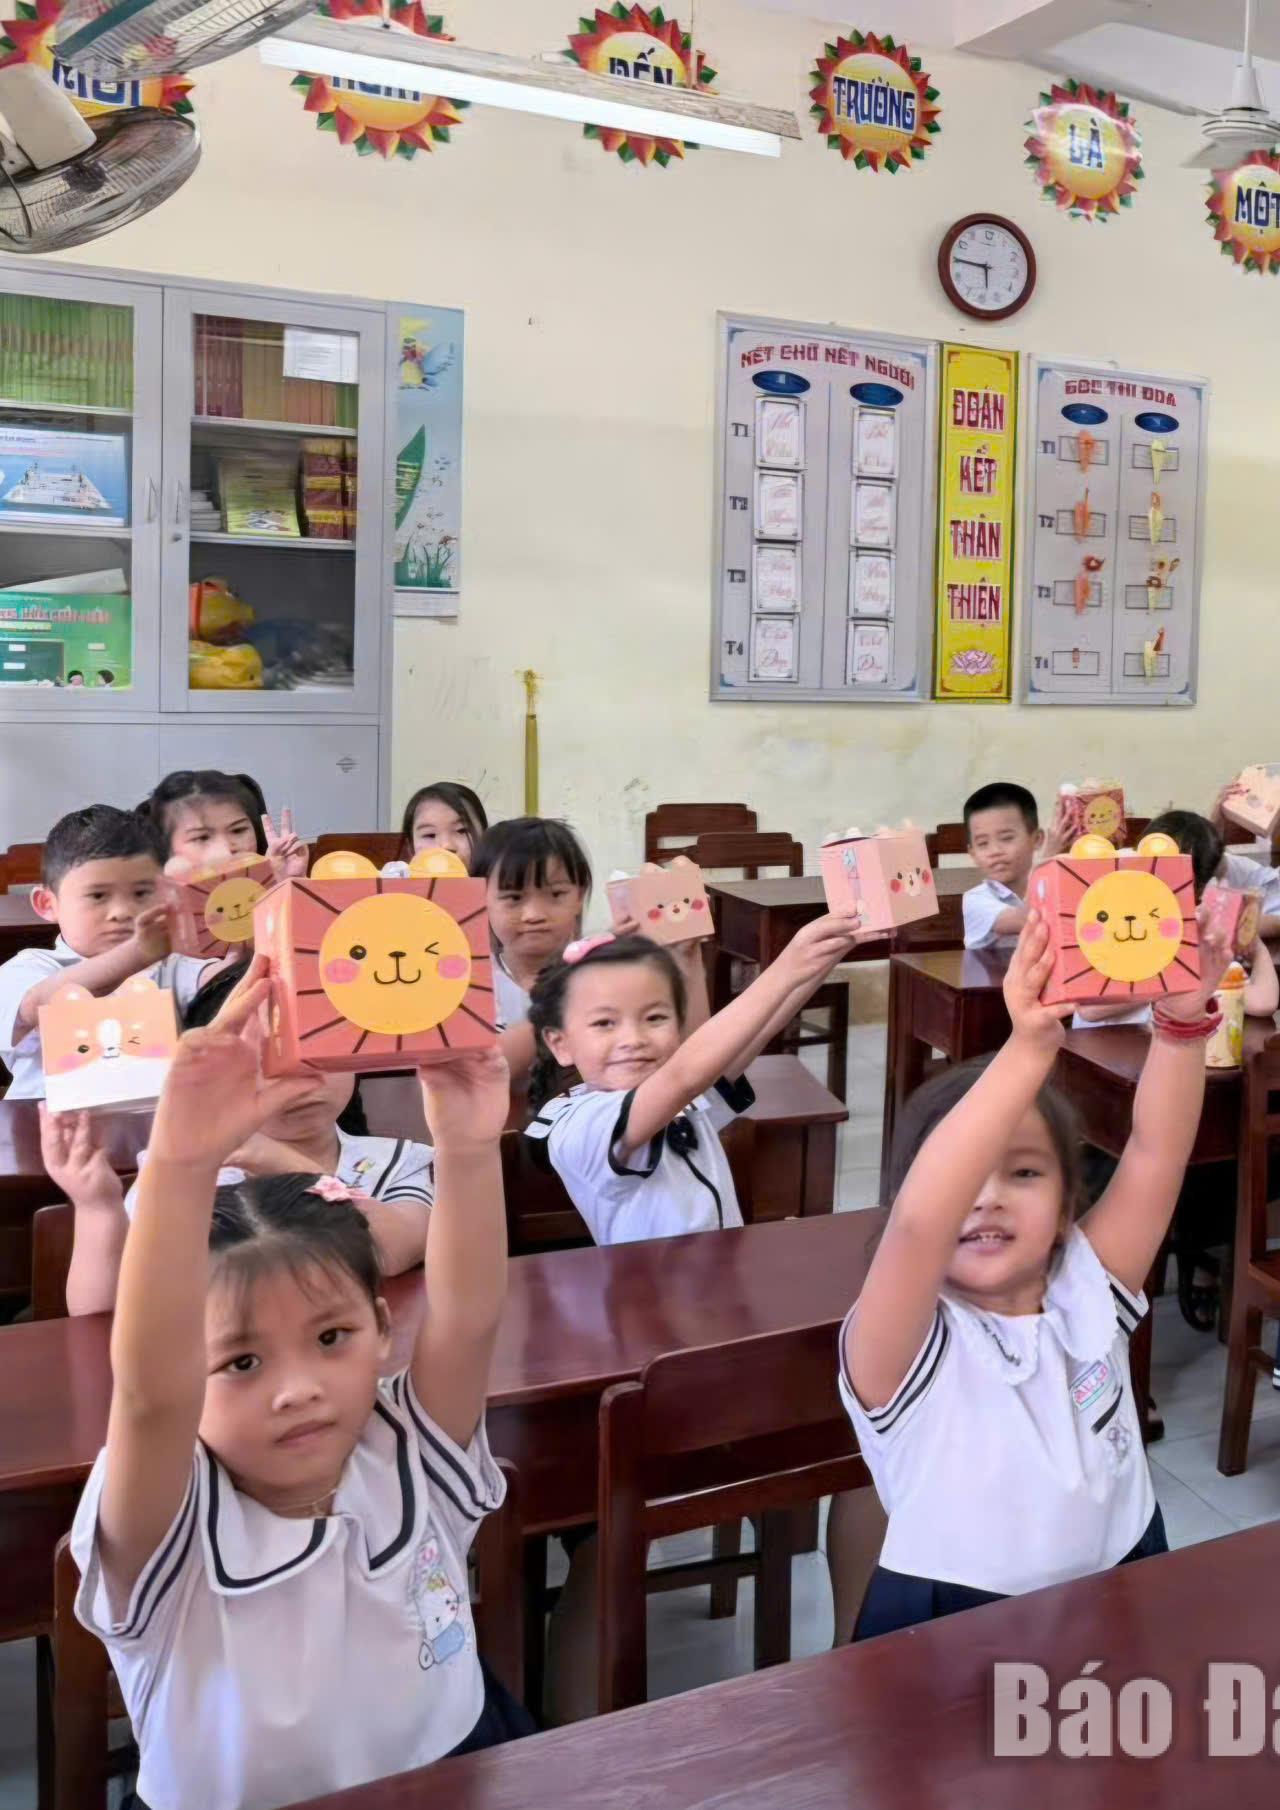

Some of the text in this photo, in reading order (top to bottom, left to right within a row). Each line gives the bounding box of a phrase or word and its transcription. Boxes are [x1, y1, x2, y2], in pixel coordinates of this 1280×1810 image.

[832, 76, 916, 131] TRƯỜNG
[1069, 118, 1104, 168] LÀ
[952, 385, 1005, 431] ĐOÀN
[960, 444, 998, 494] KẾT
[949, 513, 1001, 558] THÂN
[947, 577, 1001, 628] THIỆN
